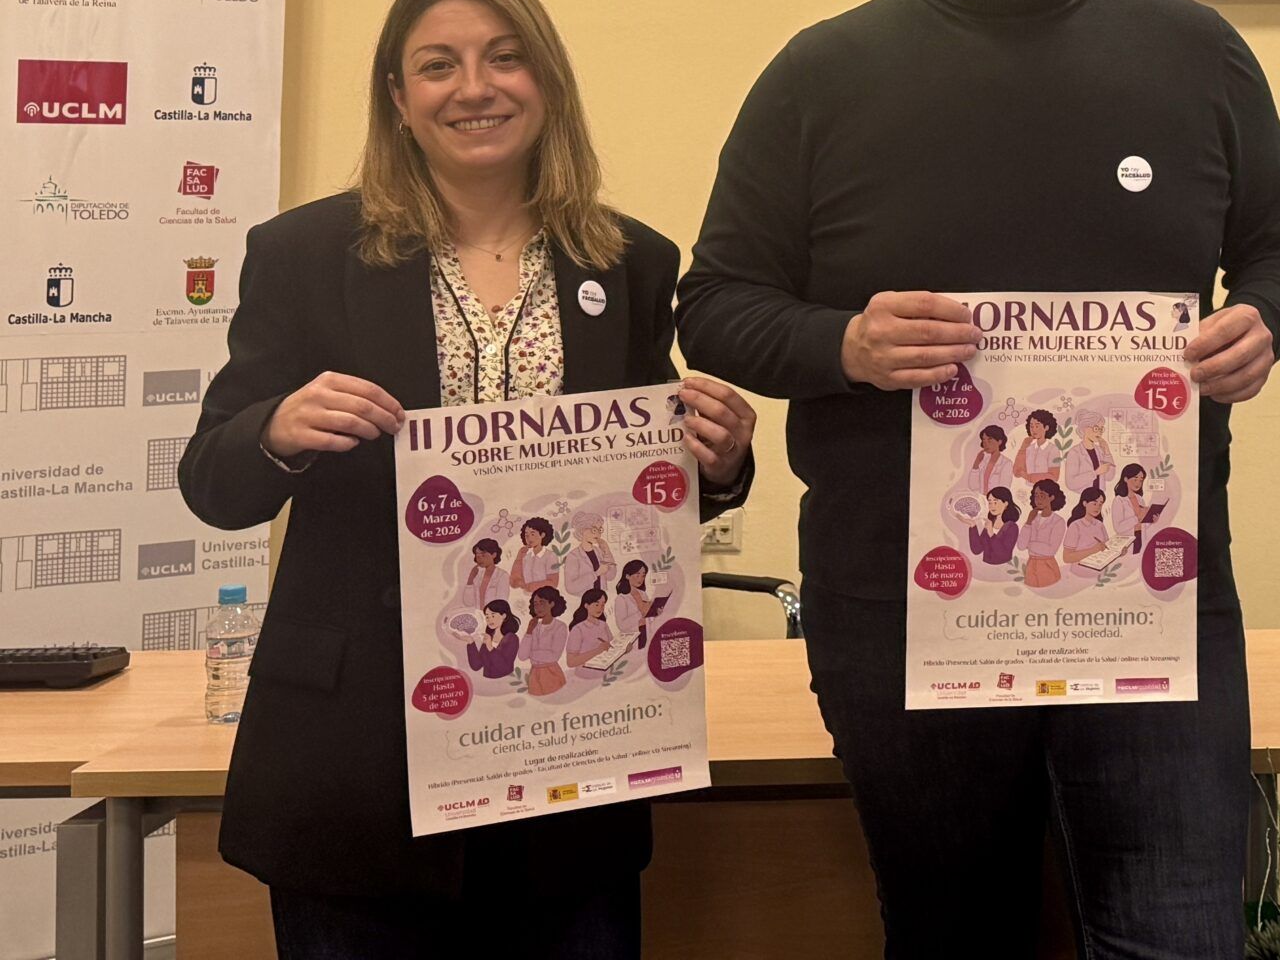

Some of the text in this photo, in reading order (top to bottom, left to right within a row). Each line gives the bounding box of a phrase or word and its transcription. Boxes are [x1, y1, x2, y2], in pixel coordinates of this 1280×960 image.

[92, 0, 117, 8] Reina
[42, 102, 122, 119] UCLM
[154, 110, 252, 122] Castilla-La Mancha
[186, 168, 207, 176] FAC
[186, 176, 200, 184] SA
[186, 184, 208, 193] LUD
[71, 202, 118, 210] DIPUTACIÓN
[176, 208, 220, 216] Facultad de
[72, 210, 130, 220] TOLEDO
[159, 216, 237, 225] Ciencias de la Salud
[8, 312, 112, 324] Castilla-La Mancha
[156, 307, 236, 318] Excmo. Ayuntamien
[962, 300, 1156, 332] ORNADAS
[153, 318, 163, 326] de
[164, 317, 198, 326] Talavera
[200, 316, 210, 324] de
[212, 316, 220, 324] la
[976, 335, 1187, 352] OBRE MUJERES Y SALUD
[984, 353, 1186, 362] VISIÓN INTERDISCIPLINAR NUEVOS HORIZONTES
[950, 378, 972, 392] 7 de
[156, 391, 198, 402] UCLM
[935, 396, 968, 405] Marzo
[1145, 388, 1183, 410] 15 €
[932, 409, 970, 418] de 2026
[409, 396, 651, 452] II JORNADAS
[451, 428, 684, 466] SOBRE MUJERES Y SALUD
[473, 446, 684, 477] VISIÓN INTERDISCIPLINAR NUEVOS HORIZONTES
[0, 464, 104, 482] niversidad de
[74, 480, 134, 495] Mancha
[644, 482, 682, 504] 15 €
[417, 494, 462, 510] 6 7 de
[423, 512, 458, 524] Marzo
[420, 525, 461, 538] de 2026
[151, 562, 192, 576] UCLM
[956, 608, 1154, 629] cuidar en femenino:
[987, 626, 1123, 641] ciencia, salud sociedad.
[459, 703, 664, 748] cuidar en femenino:
[492, 725, 632, 756] ciencia, salud sociedad.
